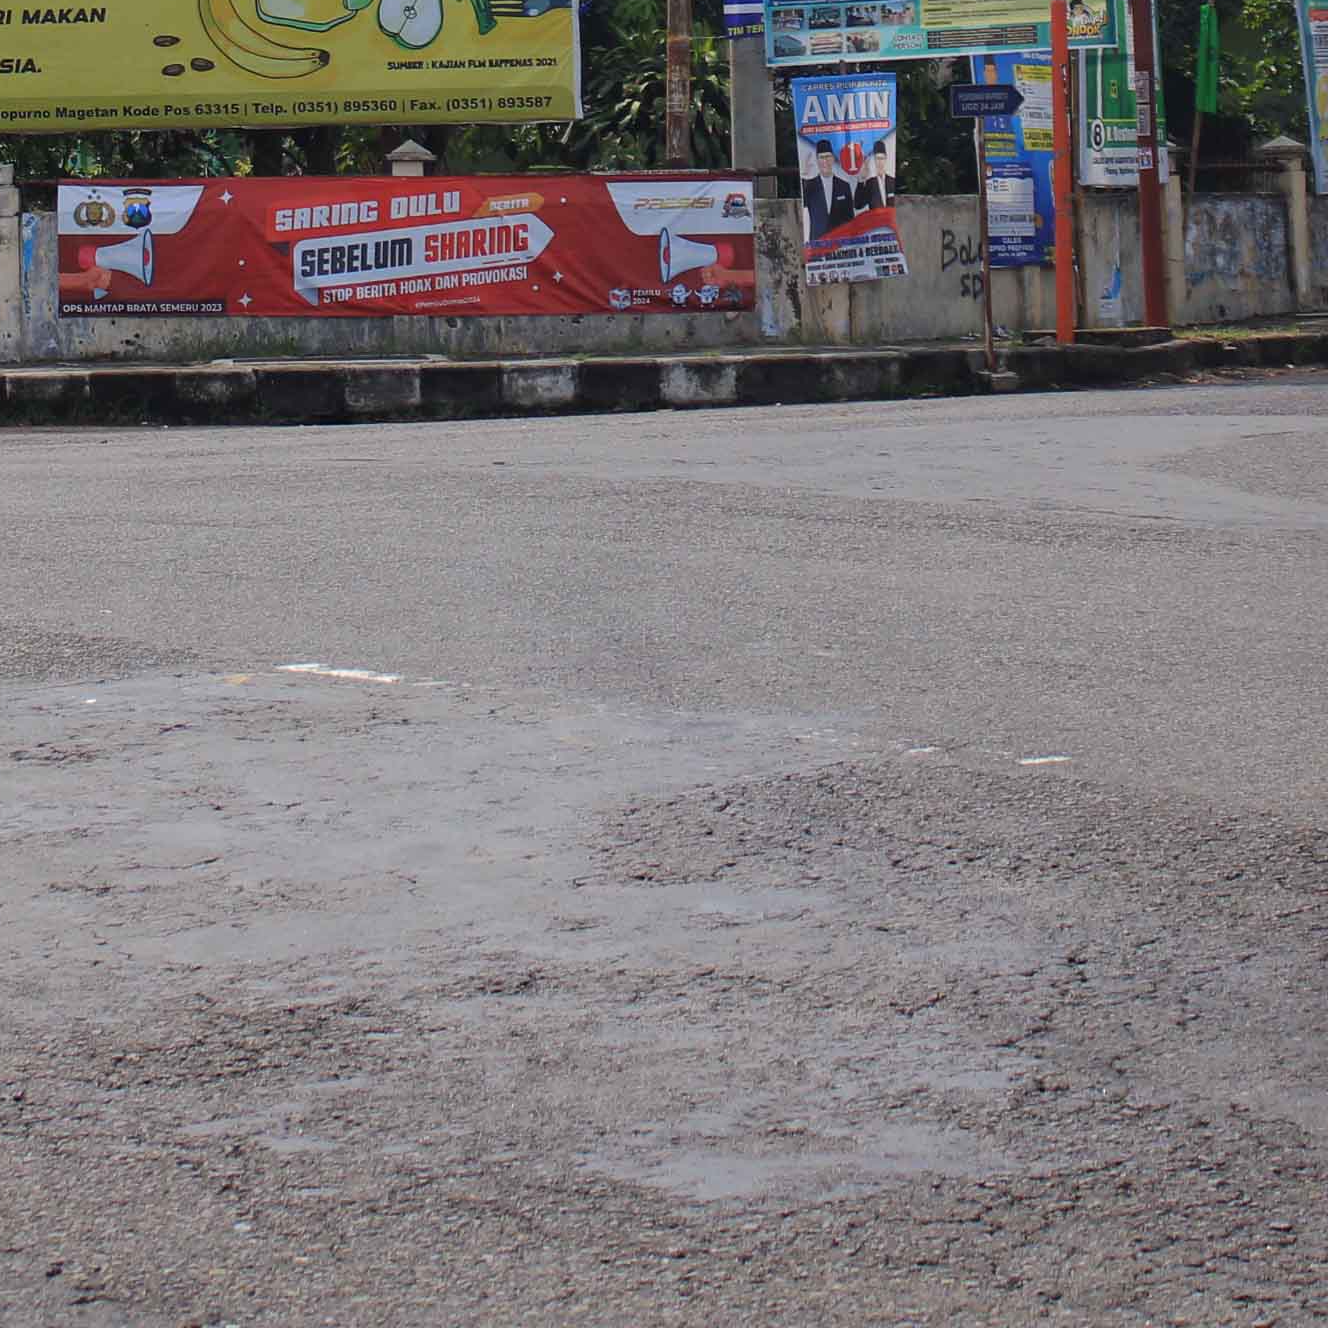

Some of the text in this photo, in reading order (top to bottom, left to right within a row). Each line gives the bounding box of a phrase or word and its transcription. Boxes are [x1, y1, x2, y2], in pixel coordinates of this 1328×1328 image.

[21, 7, 106, 25] MAKAN
[536, 57, 558, 67] 2021
[55, 105, 118, 121] Magetan
[122, 104, 160, 118] Kode
[164, 103, 190, 117] Pos
[195, 102, 240, 117] 63315
[252, 101, 288, 117] Telp.
[292, 100, 339, 115] (0351)
[343, 98, 397, 113] 895360
[410, 97, 441, 112] Fax.
[446, 96, 493, 112] (0351)
[497, 95, 554, 110] 893587
[801, 90, 891, 123] AMIN
[1093, 122, 1103, 147] 8
[845, 146, 859, 172] 1
[274, 200, 379, 232] SARING
[390, 191, 462, 219] DULU
[300, 223, 530, 278] SEBELUM SHARING
[323, 267, 529, 304] STOP BERITA HOAX DAN PROVOKASI
[62, 302, 223, 314] OPS MANTAP BRATA SEMERU 2023
